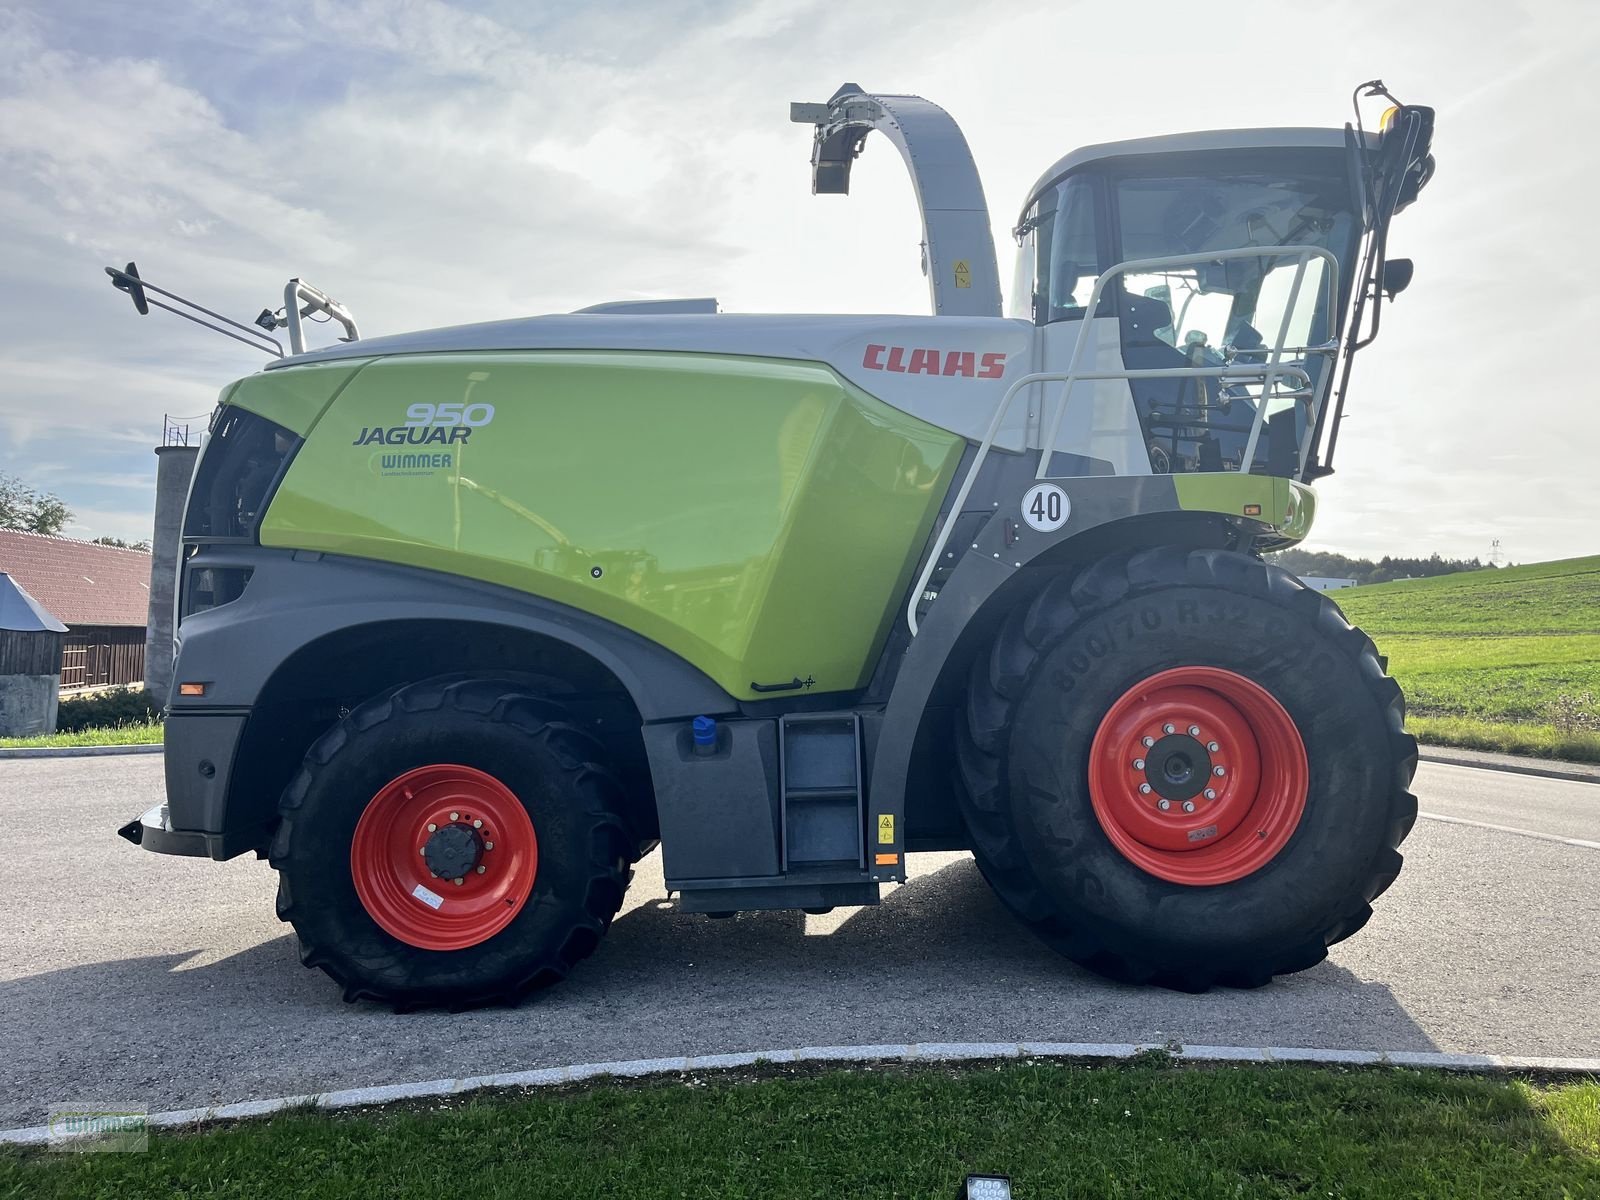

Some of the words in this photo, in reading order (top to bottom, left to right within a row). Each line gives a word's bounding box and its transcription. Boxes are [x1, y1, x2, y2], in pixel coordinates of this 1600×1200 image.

[863, 344, 1006, 378] CLAAS
[405, 403, 495, 426] 950
[352, 427, 472, 445] JAGUAR
[381, 454, 452, 468] WIMMER
[1030, 492, 1061, 522] 40
